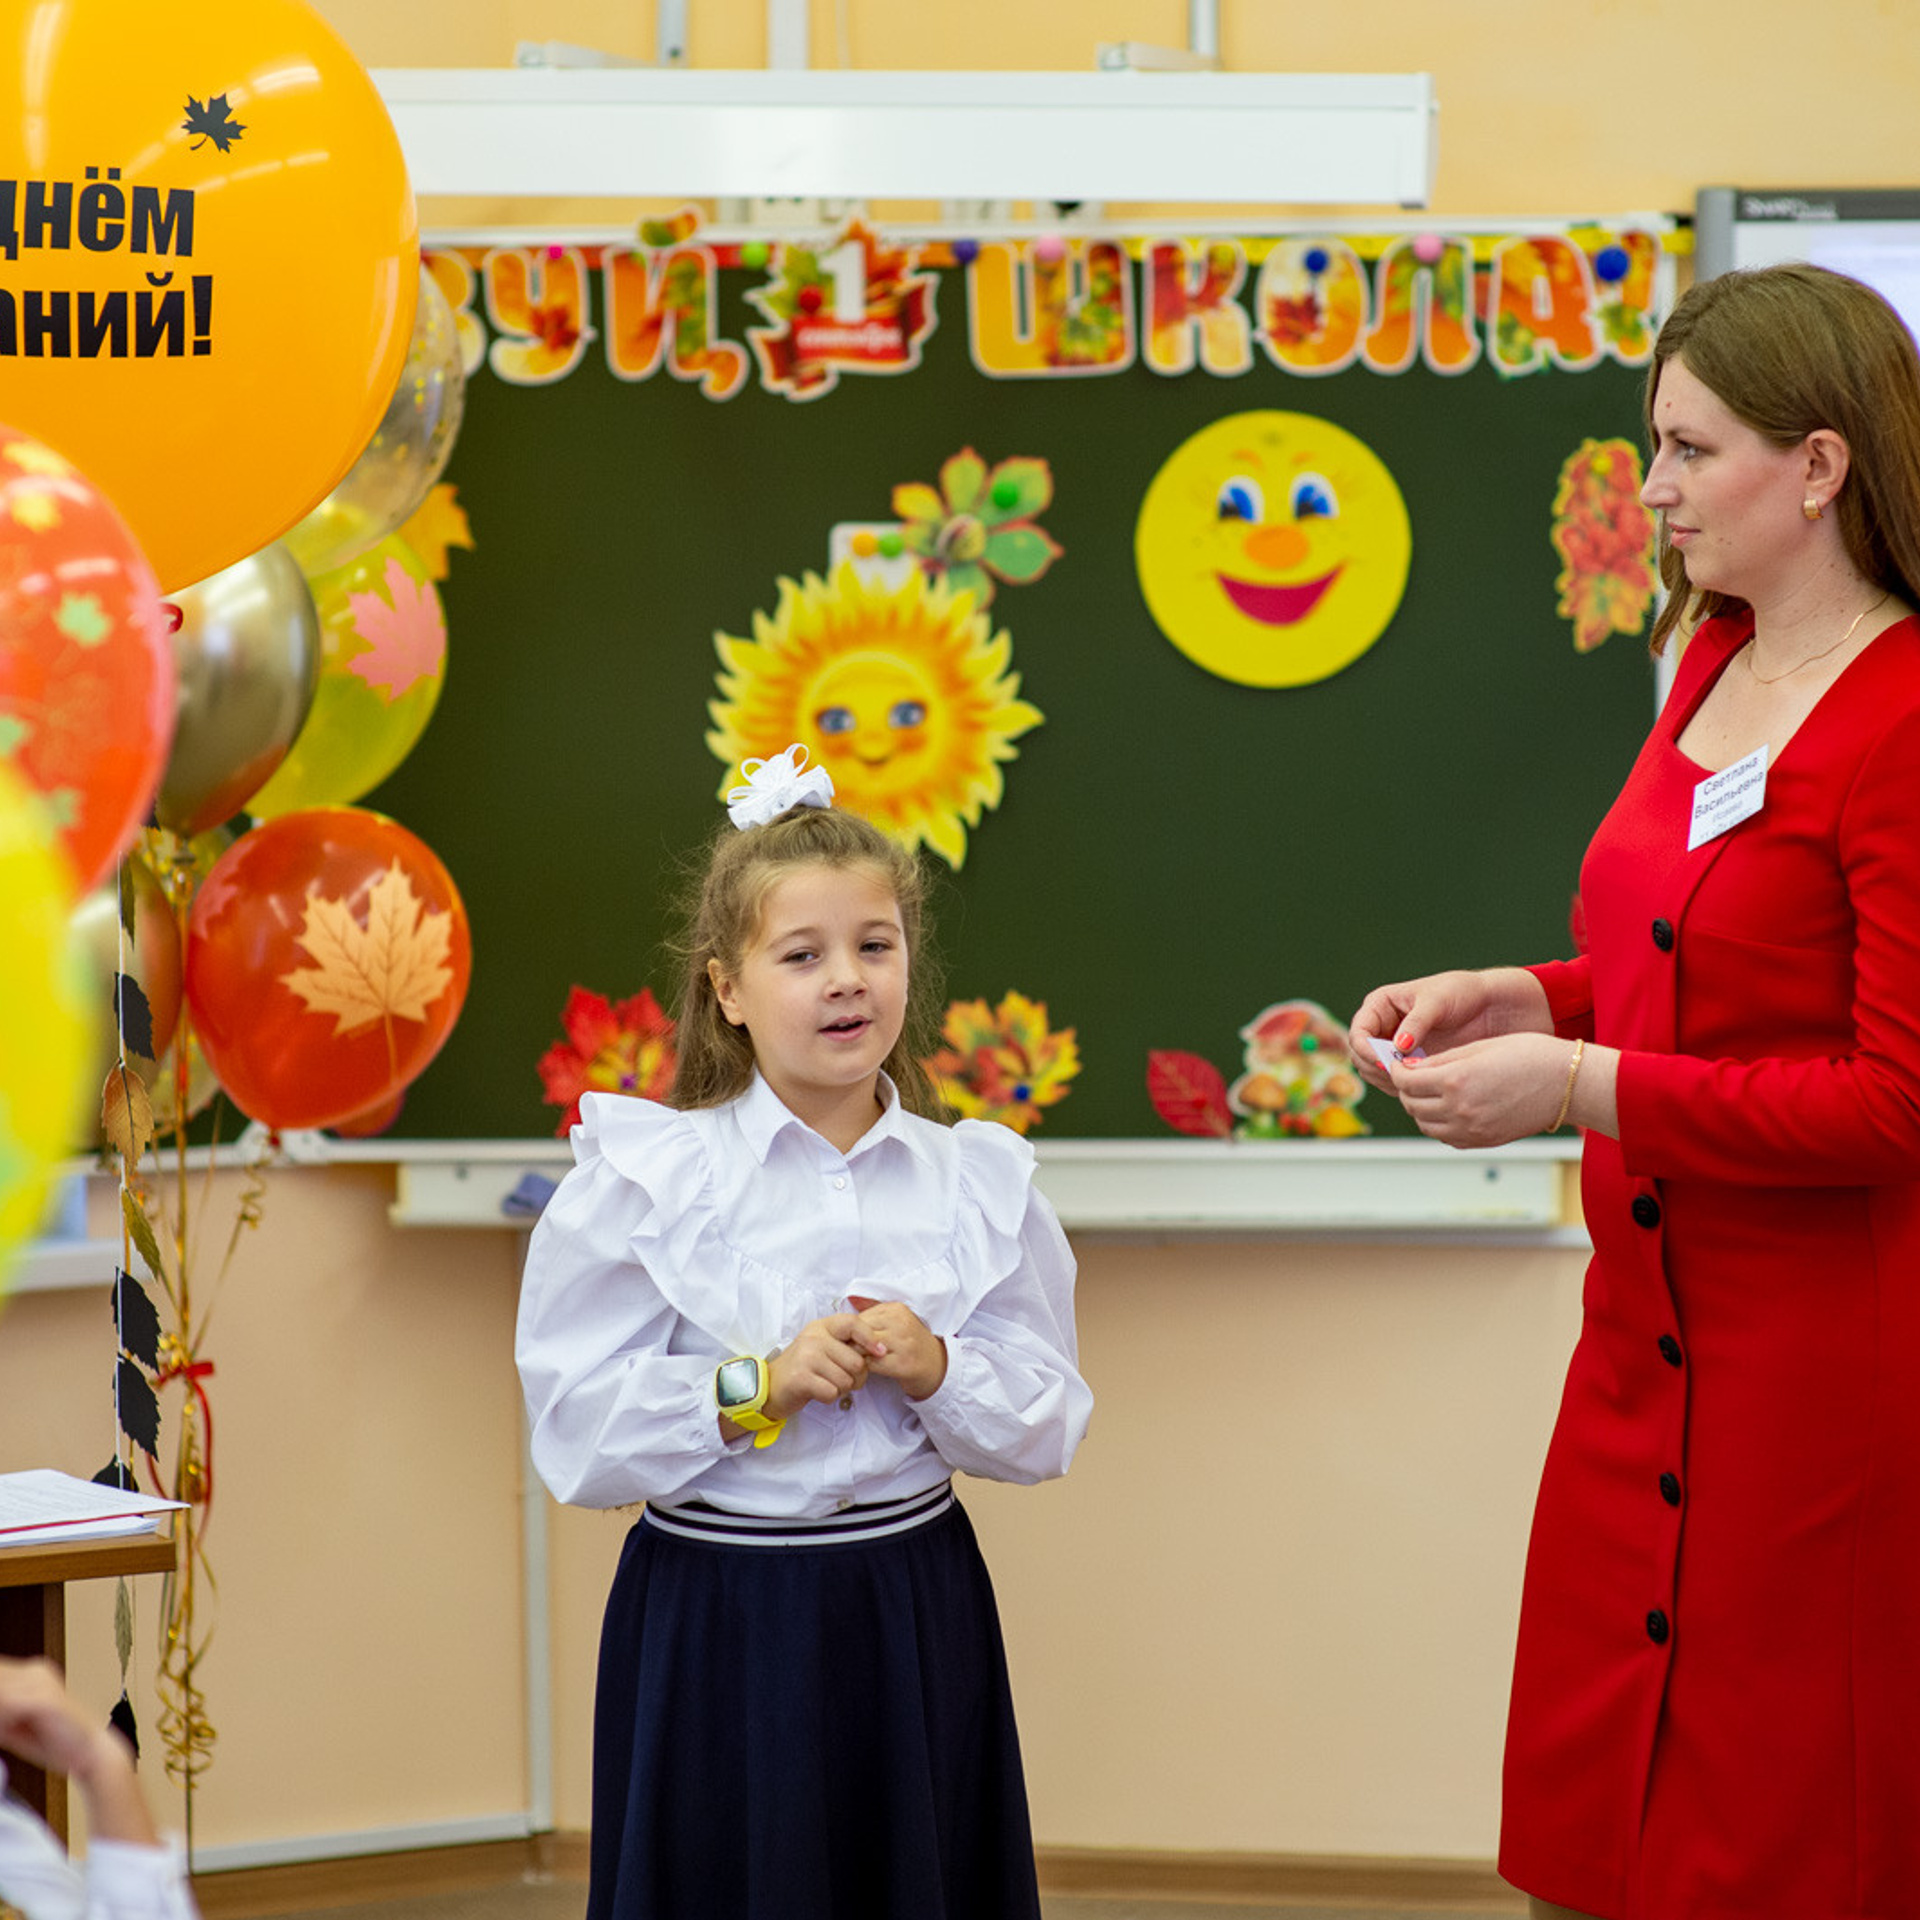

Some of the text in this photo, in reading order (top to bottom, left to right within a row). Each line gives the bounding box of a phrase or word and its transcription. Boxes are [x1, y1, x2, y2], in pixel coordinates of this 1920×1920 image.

[818, 239, 867, 325] 1
[967, 230, 1662, 380] ШКОЛА!
[1703, 757, 1758, 796] Светлана
